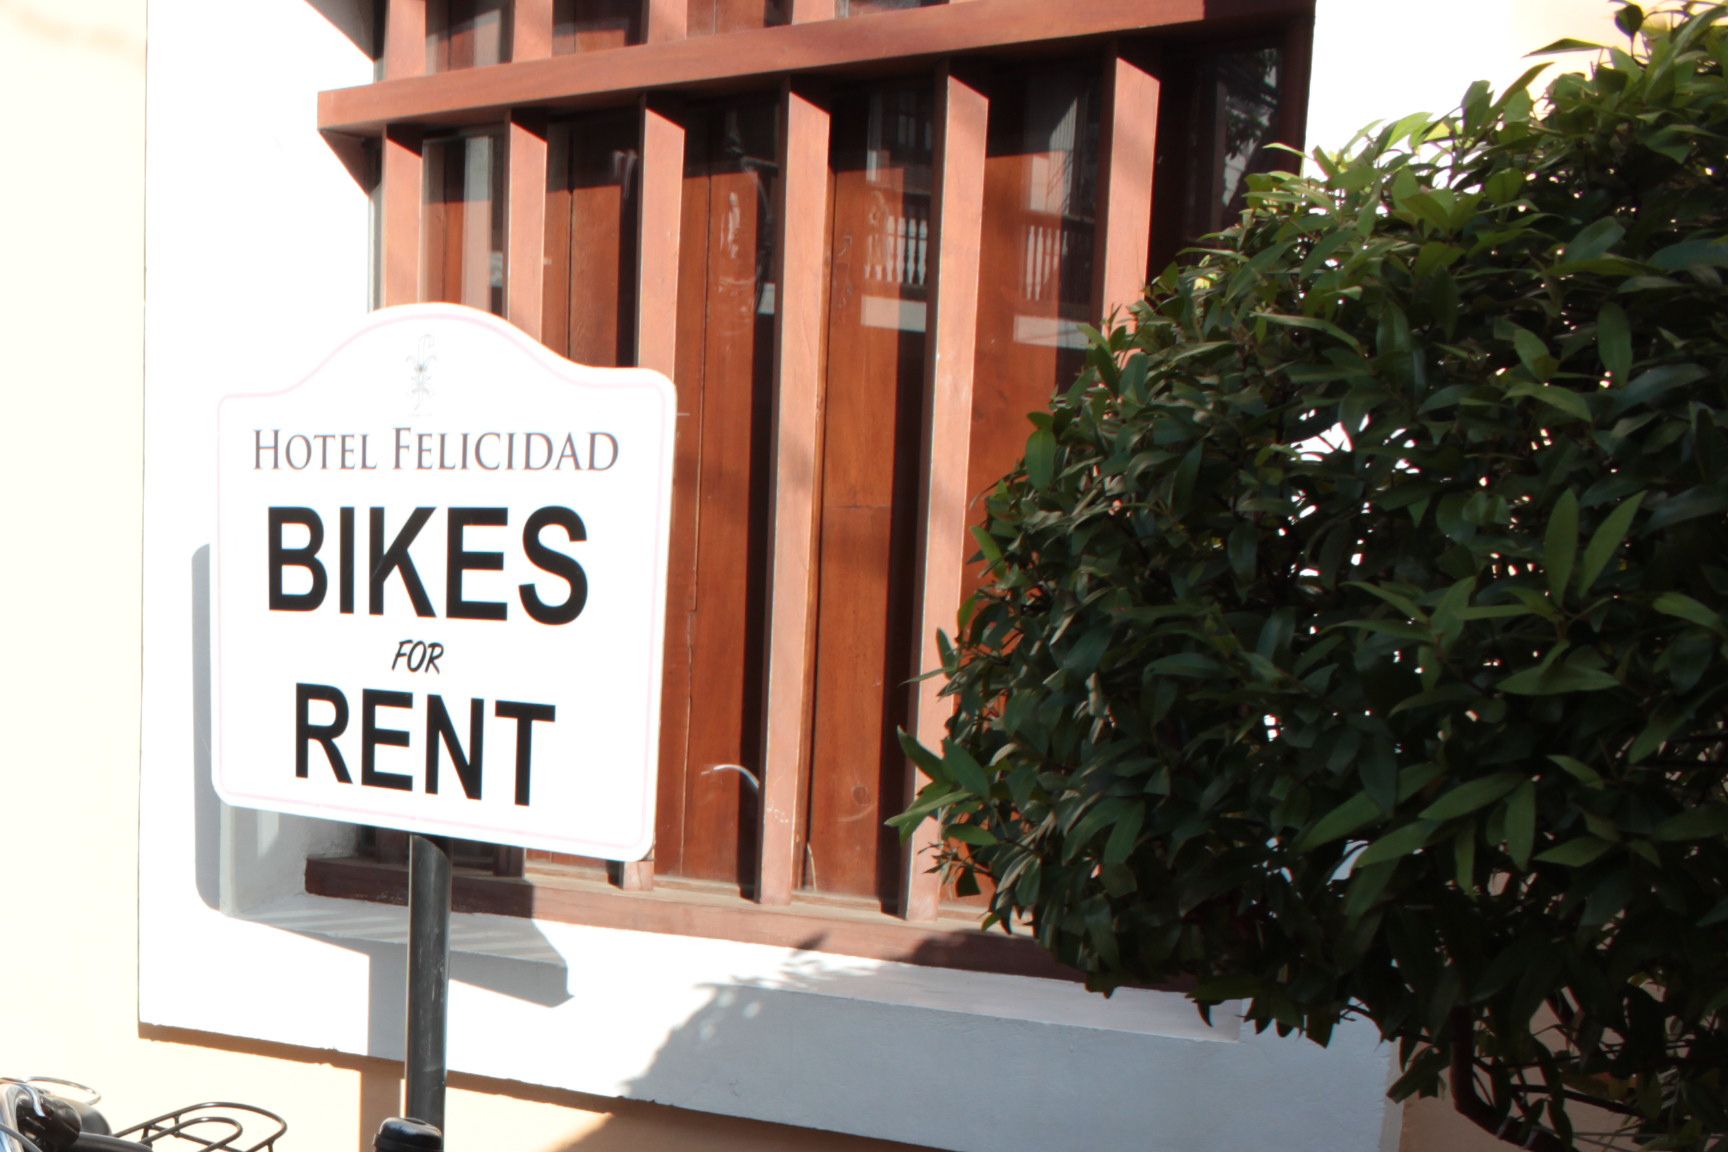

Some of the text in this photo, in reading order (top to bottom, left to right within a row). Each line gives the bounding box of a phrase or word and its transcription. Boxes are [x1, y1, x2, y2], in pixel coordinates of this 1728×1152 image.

[252, 426, 619, 472] HOTEL FELICIDAD
[267, 505, 589, 626] BIKES
[391, 638, 444, 674] FOR
[294, 681, 557, 808] RENT
